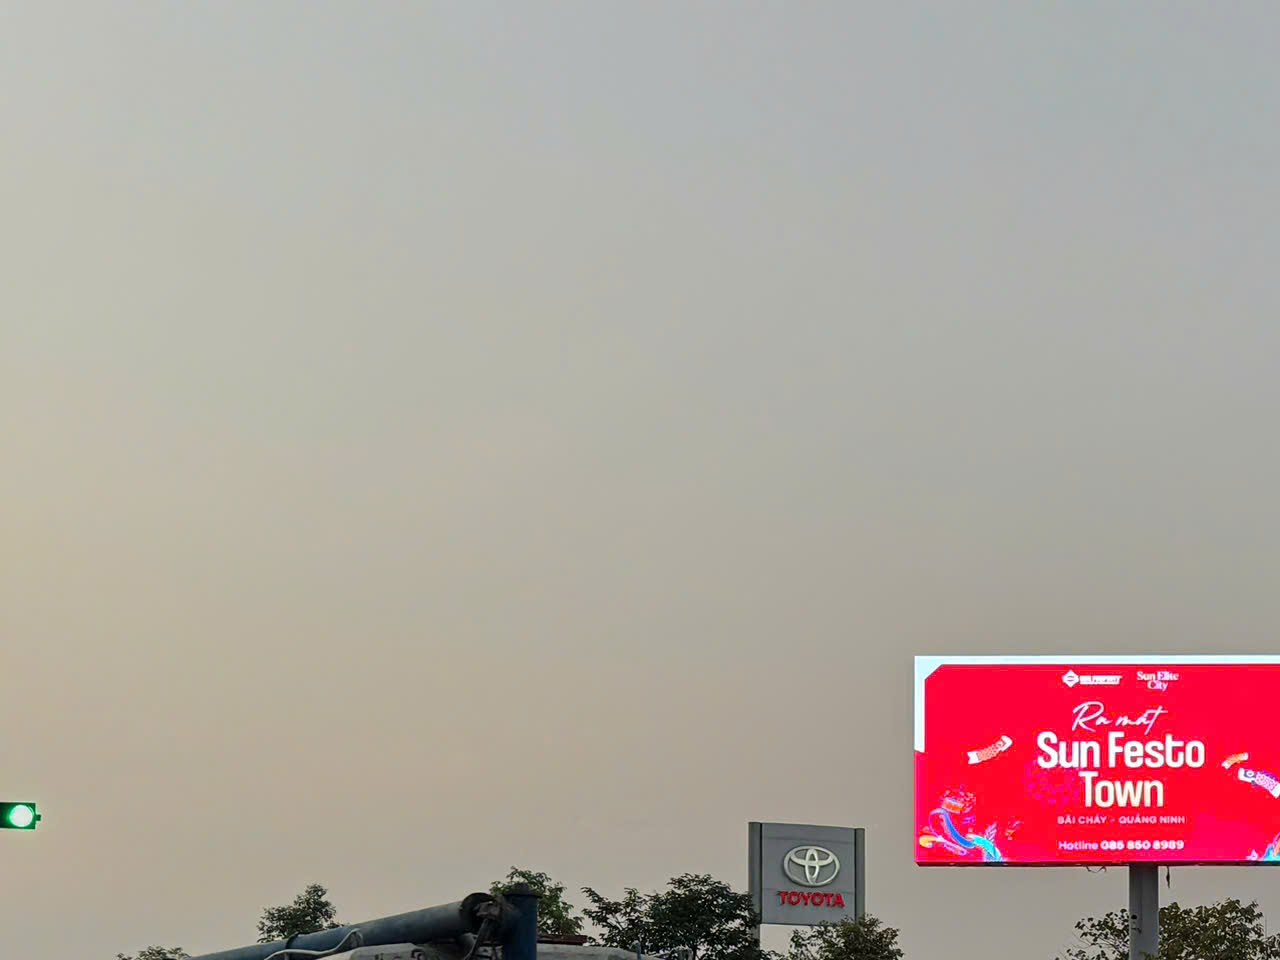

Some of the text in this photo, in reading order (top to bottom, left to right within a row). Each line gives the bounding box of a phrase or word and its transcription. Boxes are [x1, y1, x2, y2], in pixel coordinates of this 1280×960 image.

[1136, 671, 1156, 681] Sun
[1037, 731, 1205, 768] Sun Festo
[1078, 770, 1164, 808] Town
[1159, 815, 1185, 824] NINH
[1058, 840, 1098, 850] Hotline
[777, 891, 845, 908] TOYOTA
